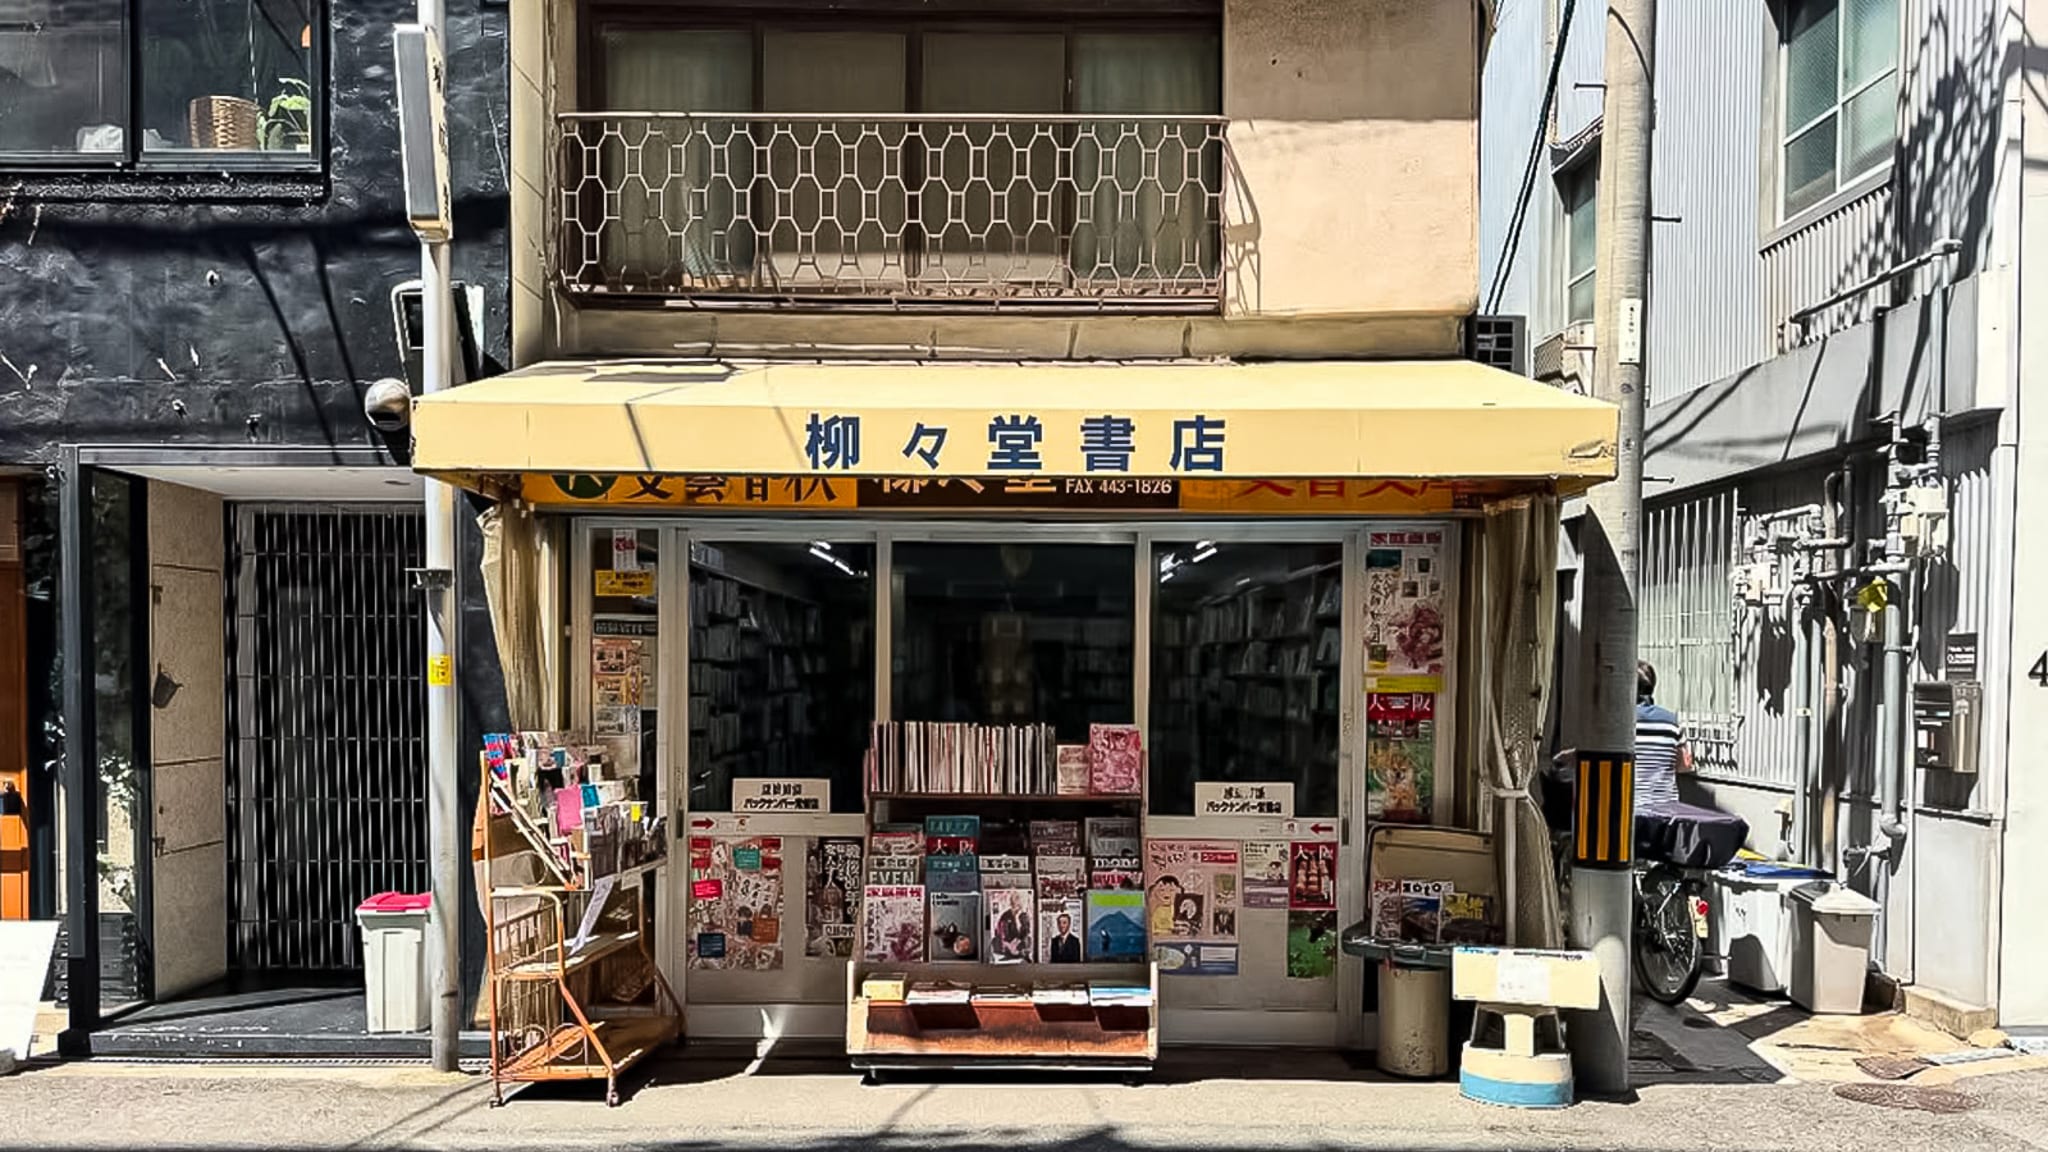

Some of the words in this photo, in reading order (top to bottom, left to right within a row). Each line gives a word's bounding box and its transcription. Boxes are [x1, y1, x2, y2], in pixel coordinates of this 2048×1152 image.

[805, 413, 1225, 471] 柳々堂書店
[1065, 478, 1094, 494] FAX
[1099, 478, 1172, 494] 443-1826
